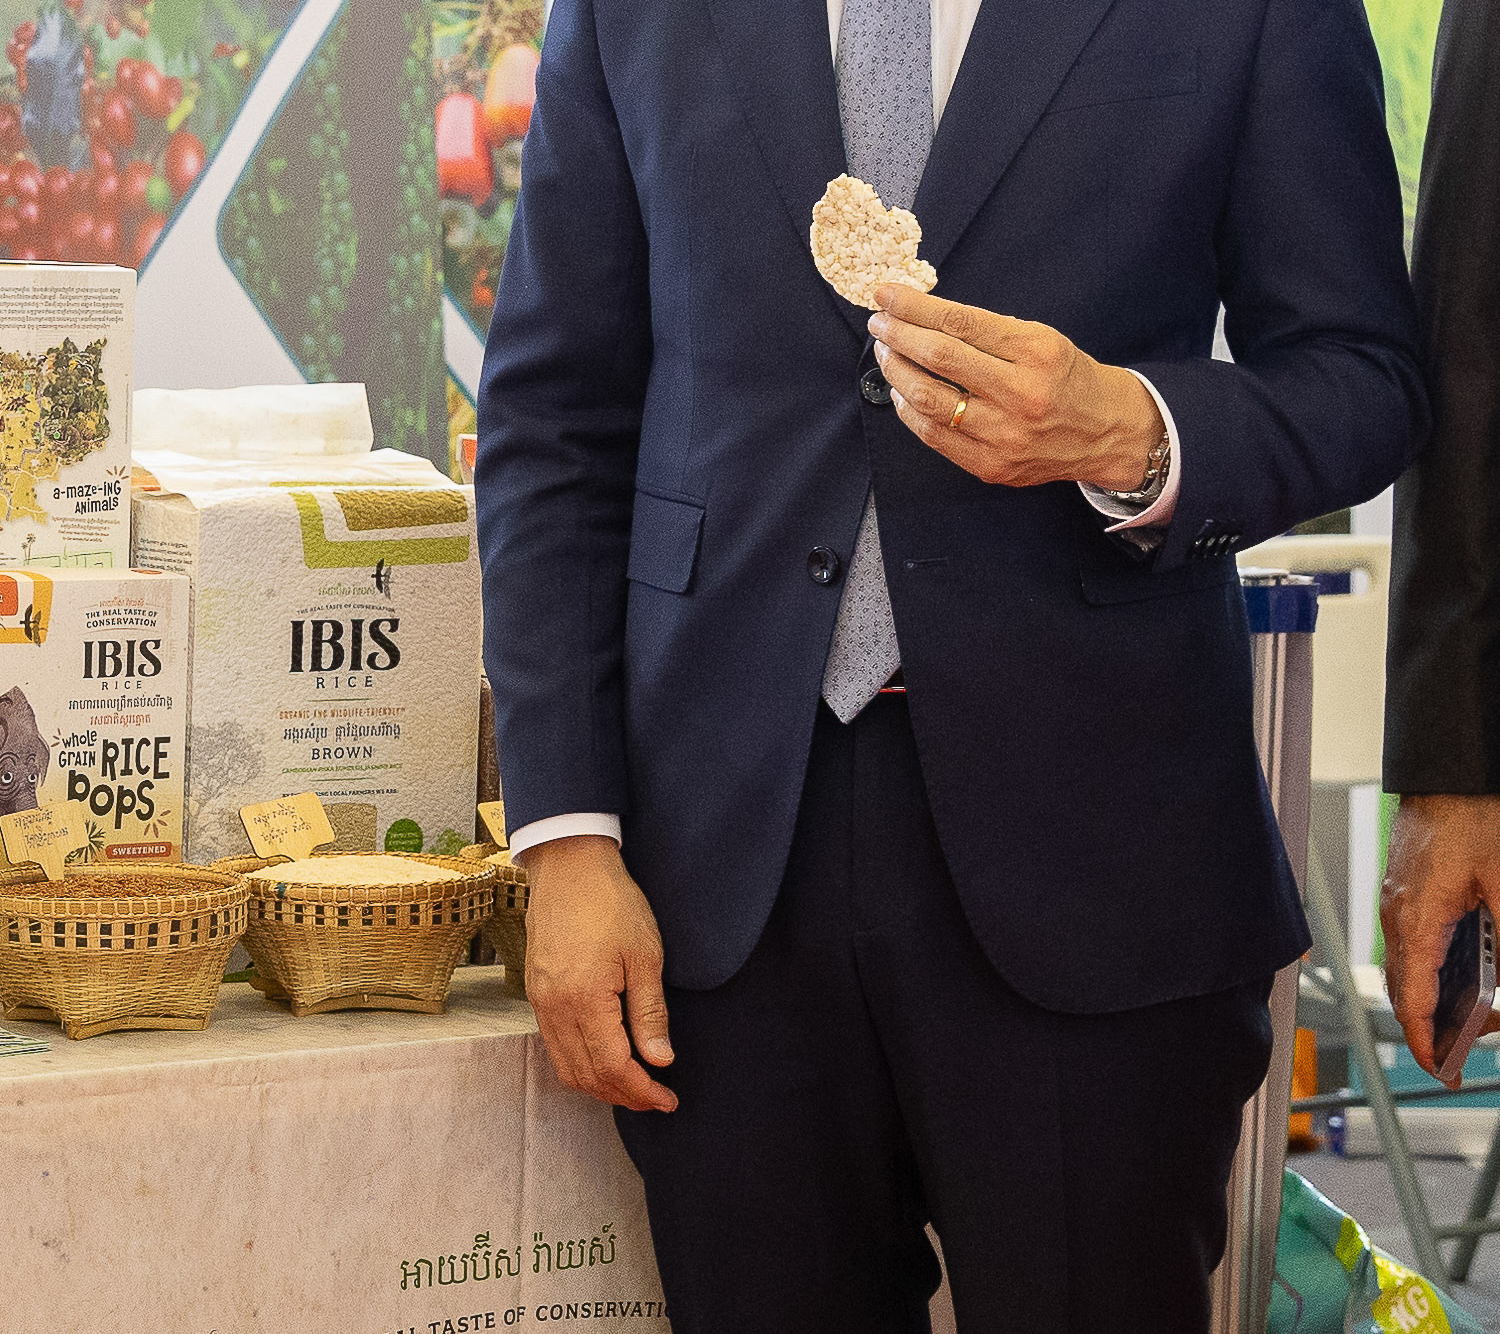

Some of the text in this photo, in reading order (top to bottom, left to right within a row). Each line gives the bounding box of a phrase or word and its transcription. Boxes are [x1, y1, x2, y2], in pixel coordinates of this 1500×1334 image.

[85, 608, 158, 619] THE REAL TASTE OF
[86, 617, 157, 628] CONSERVATION
[289, 618, 401, 673] IBIS
[83, 639, 161, 680] IBIS
[102, 680, 143, 690] RICE
[315, 676, 373, 688] RICE
[279, 710, 310, 720] ORGANIC
[101, 736, 171, 781] RICE
[311, 746, 374, 760] BROWN
[112, 844, 167, 857] SWEETENED
[502, 1305, 527, 1326] OF
